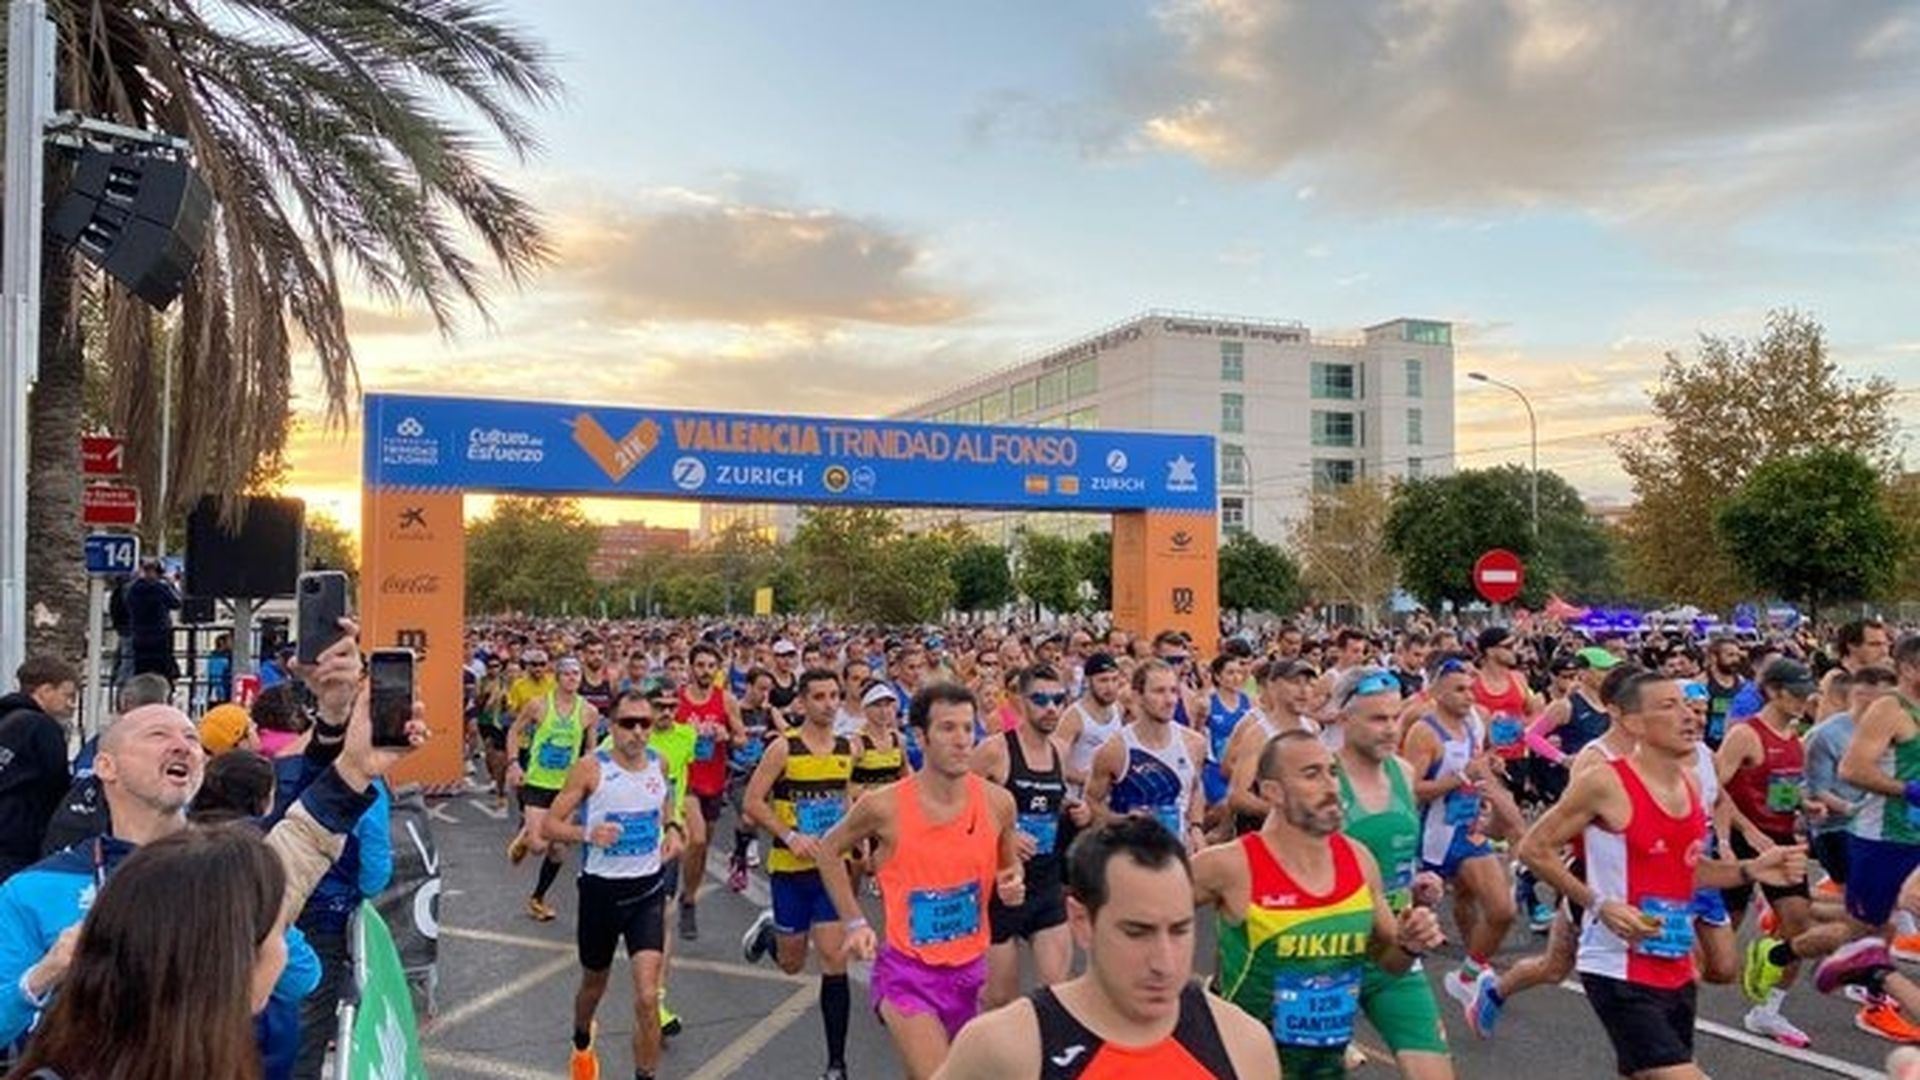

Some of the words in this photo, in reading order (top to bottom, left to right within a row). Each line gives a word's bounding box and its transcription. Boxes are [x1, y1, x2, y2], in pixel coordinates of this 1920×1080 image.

[467, 443, 544, 462] Esfuerzo
[674, 419, 822, 456] VALENCIA
[823, 426, 950, 462] TRINIDAD
[953, 432, 1078, 467] ALFONSO
[716, 465, 804, 486] ZURICH
[1090, 477, 1146, 492] ZURICH
[104, 542, 132, 567] 14
